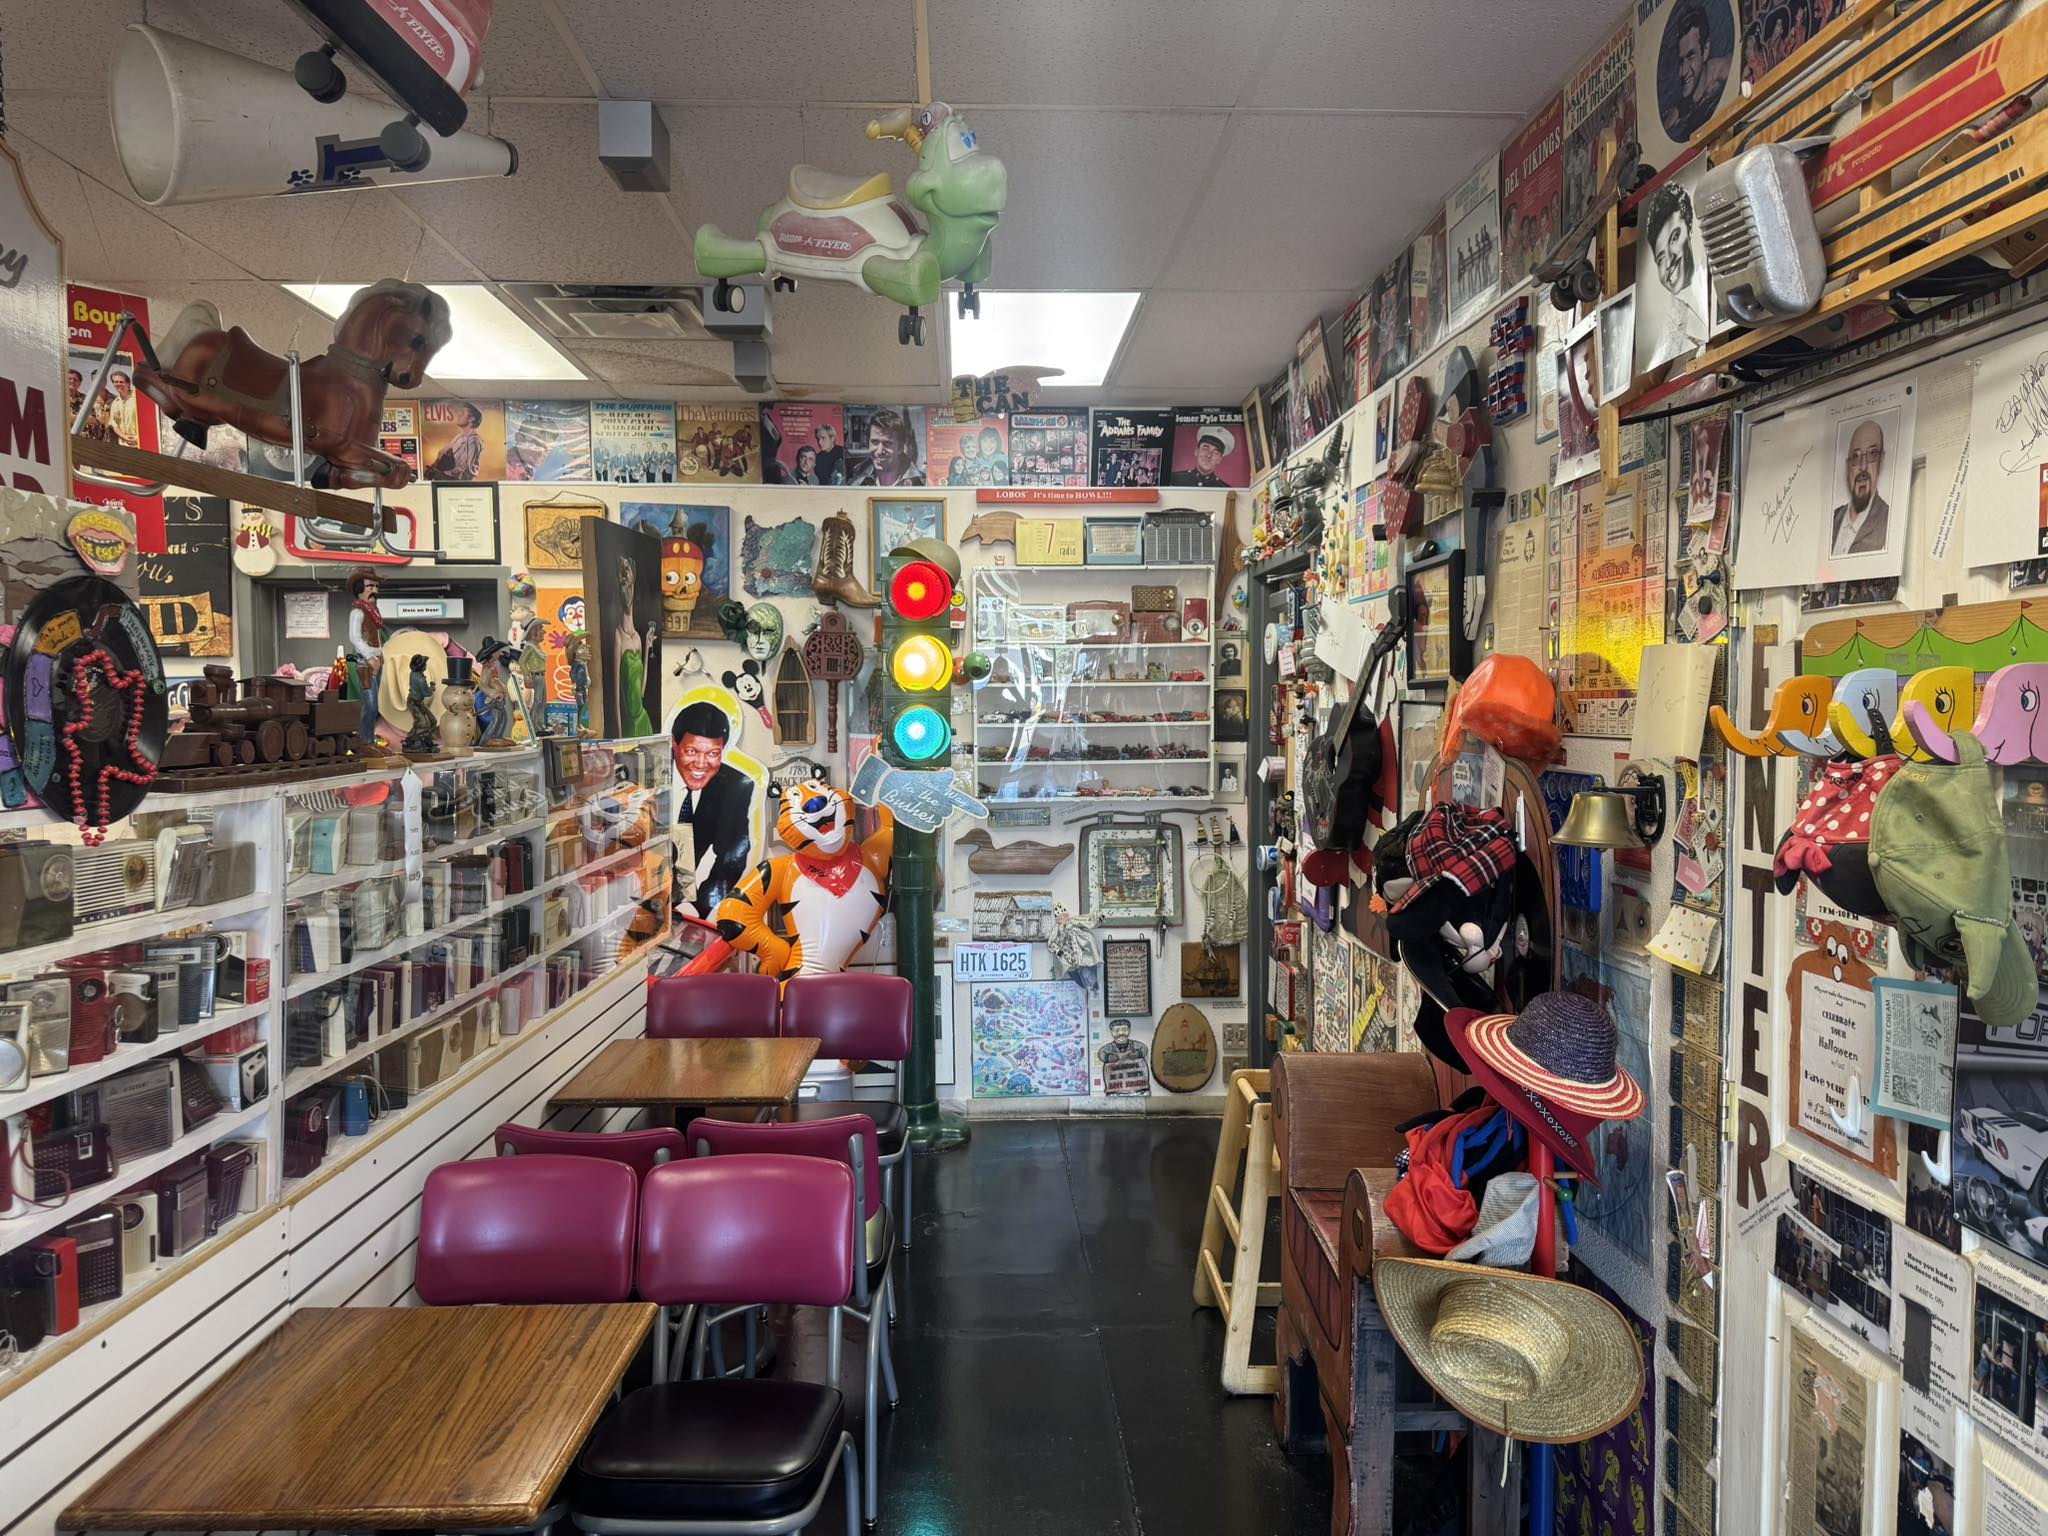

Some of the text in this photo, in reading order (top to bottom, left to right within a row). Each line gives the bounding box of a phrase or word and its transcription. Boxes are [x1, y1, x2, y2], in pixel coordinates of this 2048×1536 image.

[406, 19, 445, 58] FLYER
[1504, 167, 1520, 198] DEL
[1522, 126, 1561, 180] VIKINGS
[816, 240, 852, 251] FLYER
[424, 403, 454, 422] ELVIS
[595, 403, 618, 411] THE
[679, 404, 756, 422] The Ventures
[1100, 424, 1165, 438] ADDAMS FAMILY
[1116, 416, 1132, 427] THE
[1033, 491, 1047, 499] It's
[1048, 491, 1064, 499] time
[1065, 491, 1074, 499] to
[1044, 522, 1056, 554] 7
[788, 766, 808, 775] 1783
[902, 782, 940, 807] to the
[944, 788, 968, 809] Way
[882, 788, 936, 824] Bushes
[80, 910, 121, 923] Knight
[960, 952, 1027, 972] HTK 1625
[1818, 1035, 1859, 1062] Halloween
[1886, 1046, 1890, 1056] OF
[1804, 1070, 1846, 1096] Have your
[1883, 1058, 1891, 1093] HISTORY
[1825, 1092, 1846, 1110] here
[1906, 1252, 1922, 1266] Have
[1923, 1260, 1935, 1272] you
[1936, 1267, 1948, 1280] had
[1978, 1261, 2022, 1288] Health Department
[1904, 1260, 1958, 1294] kindness shown?
[1950, 1323, 1960, 1333] for
[1972, 1394, 1980, 1404] On
[1980, 1400, 2000, 1419] Monday,
[2001, 1412, 2012, 1425] June
[1986, 1414, 2004, 1430] serving
[2020, 1438, 2034, 1451] Open
